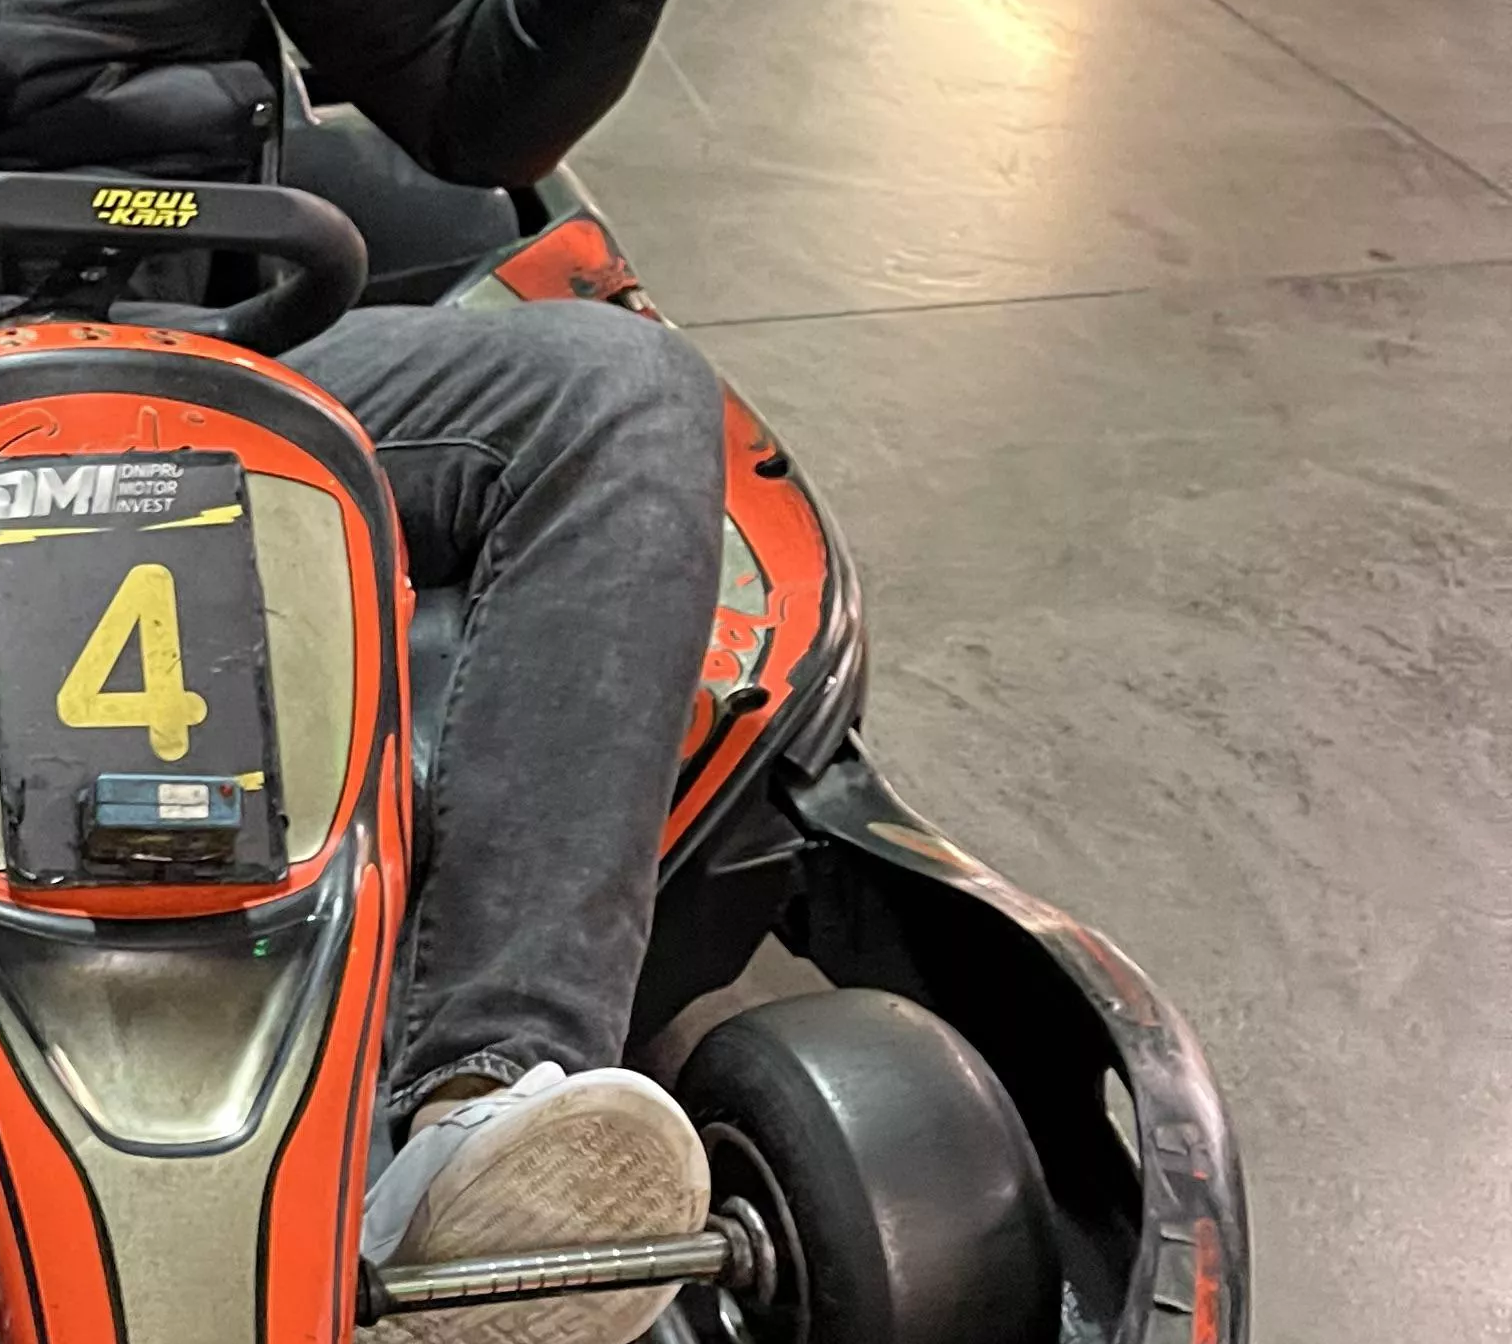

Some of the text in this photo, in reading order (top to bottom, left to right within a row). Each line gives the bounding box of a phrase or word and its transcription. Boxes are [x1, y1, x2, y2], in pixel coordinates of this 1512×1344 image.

[118, 480, 178, 496] MOTOR
[117, 497, 177, 514] INVEST
[56, 563, 208, 762] 4
